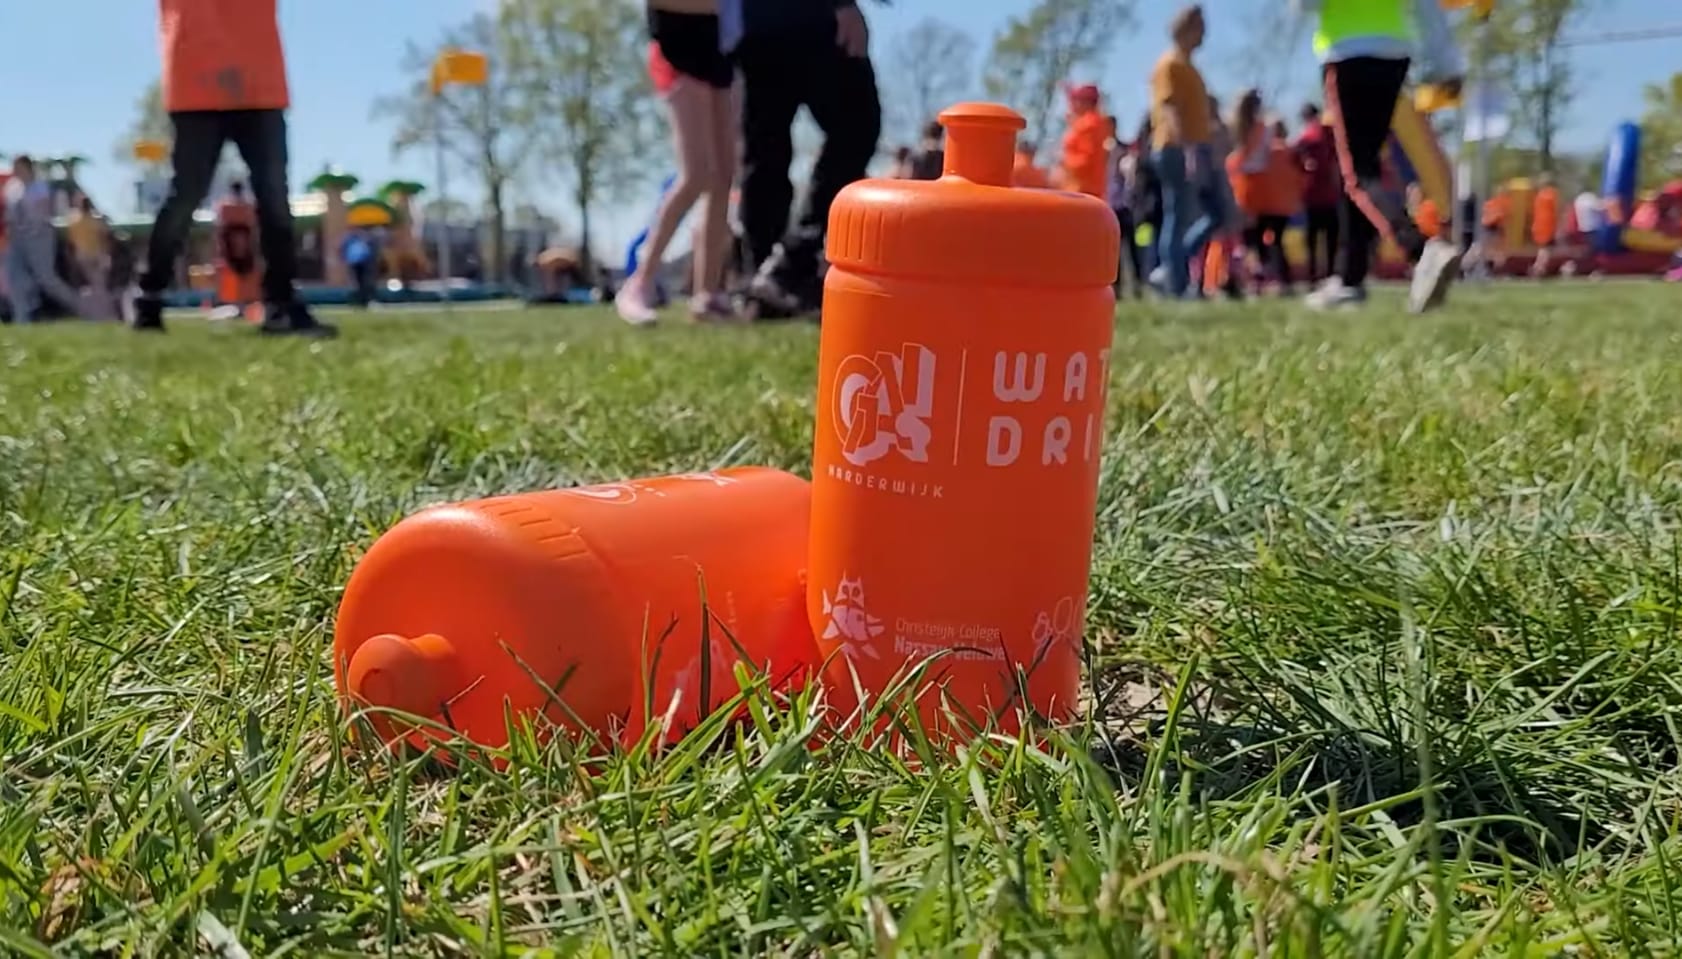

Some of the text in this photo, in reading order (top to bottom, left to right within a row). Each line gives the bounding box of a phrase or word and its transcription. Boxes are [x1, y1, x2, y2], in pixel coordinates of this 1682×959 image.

[986, 415, 1092, 466] DRI
[829, 465, 943, 498] HARDERWIJK
[896, 617, 1001, 641] Christelijk College
